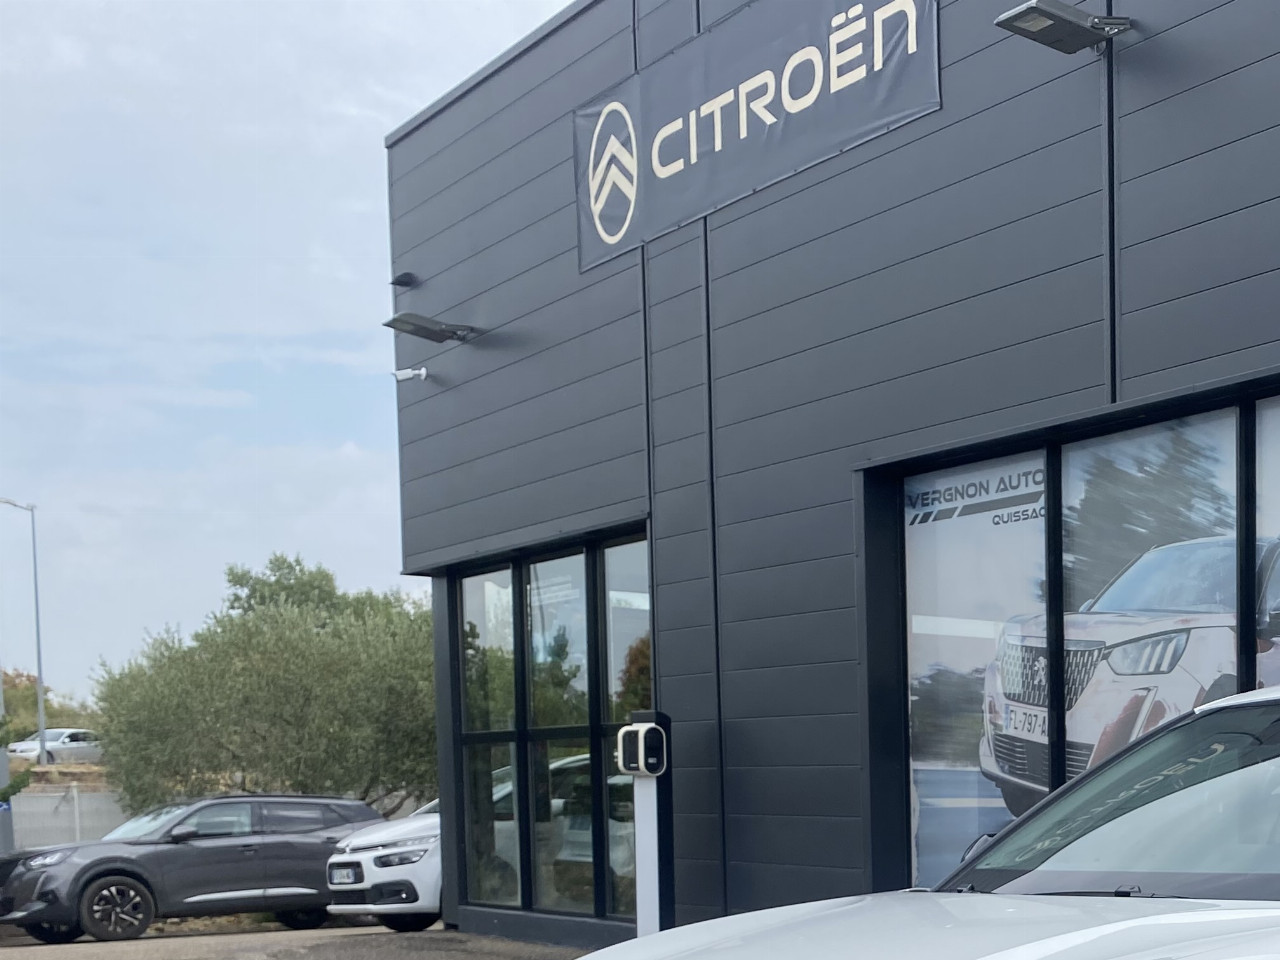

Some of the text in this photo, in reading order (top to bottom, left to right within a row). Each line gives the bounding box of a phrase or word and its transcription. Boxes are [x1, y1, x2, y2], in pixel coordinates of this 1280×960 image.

[651, 0, 918, 179] CITROËN
[909, 468, 1046, 509] VERGNON AUTO
[1009, 710, 1047, 736] FL-797-A
